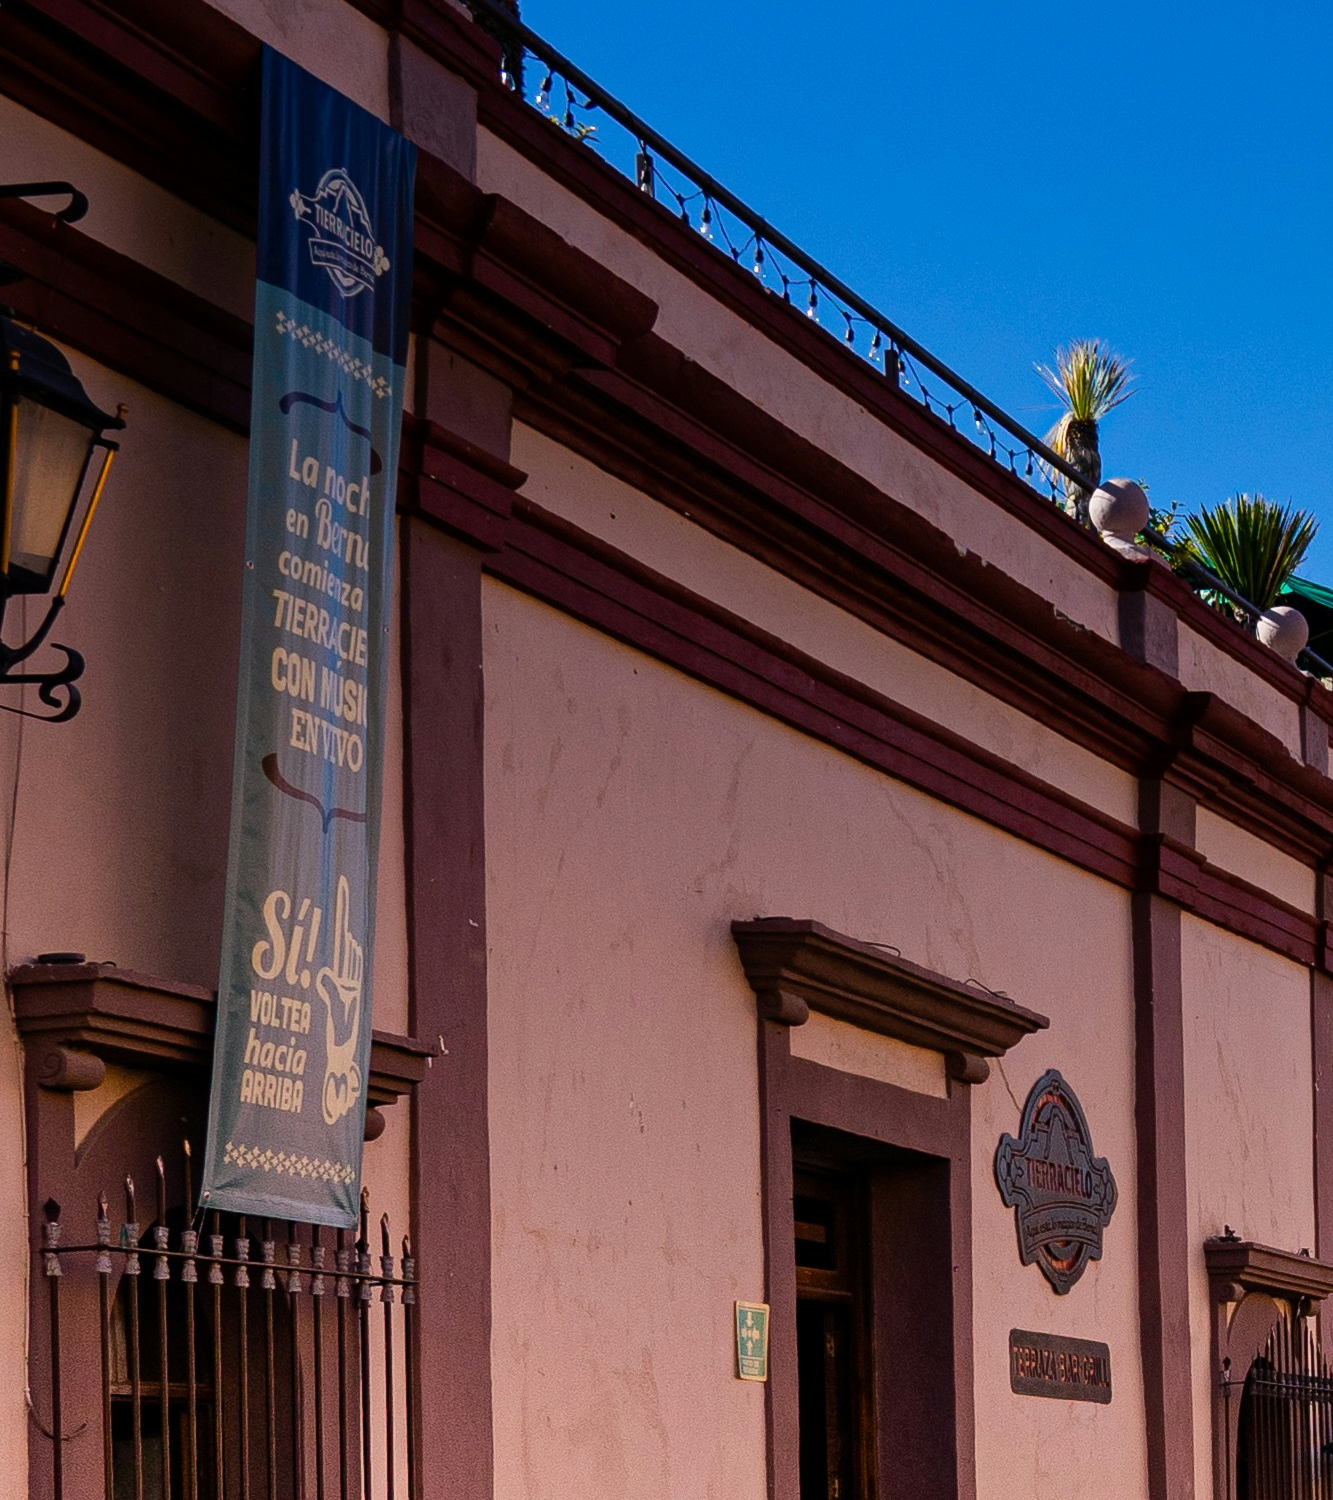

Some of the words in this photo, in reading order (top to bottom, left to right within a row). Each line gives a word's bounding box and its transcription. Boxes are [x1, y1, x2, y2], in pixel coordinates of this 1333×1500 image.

[289, 438, 320, 488] La
[286, 508, 309, 539] en
[279, 551, 364, 612] comienza
[271, 647, 316, 703] CON
[289, 708, 320, 755] EN
[320, 720, 363, 773] VIVO
[251, 890, 322, 989] Sí!
[250, 989, 311, 1034] VOLTEA
[244, 1028, 307, 1075] hacia
[240, 1068, 304, 1114] ARRIBA
[1024, 1156, 1093, 1199] TIERRACIELO
